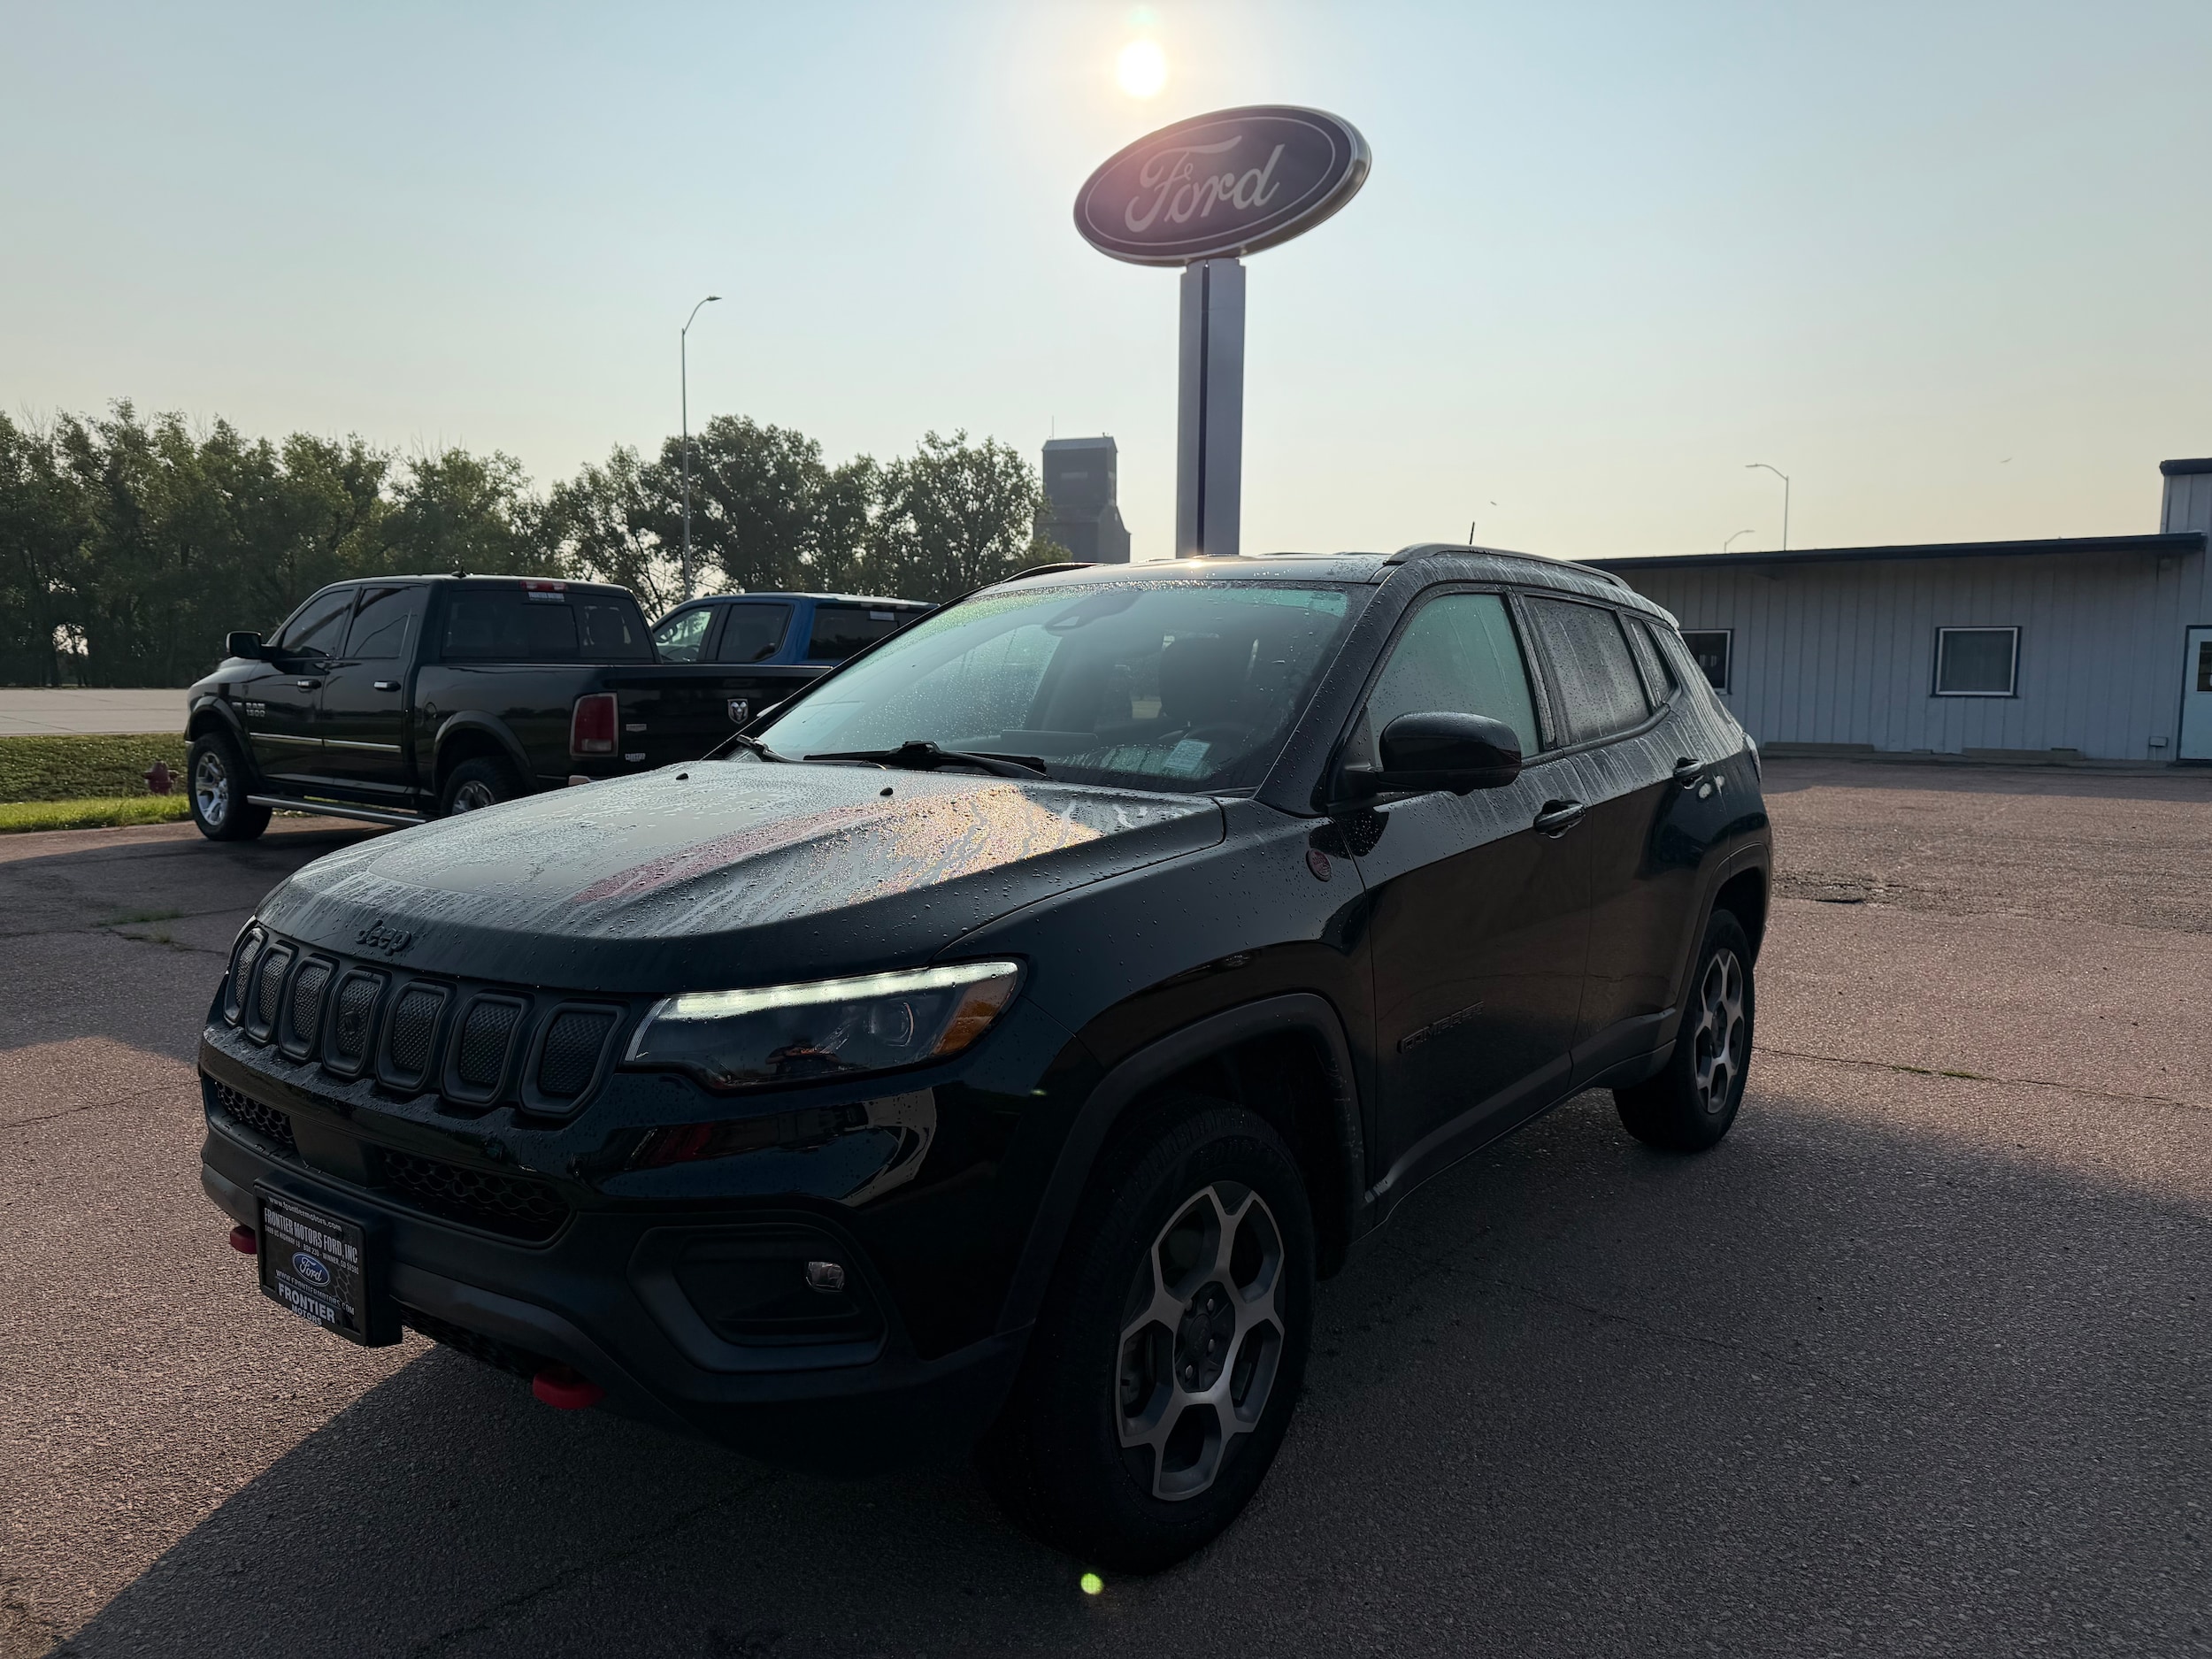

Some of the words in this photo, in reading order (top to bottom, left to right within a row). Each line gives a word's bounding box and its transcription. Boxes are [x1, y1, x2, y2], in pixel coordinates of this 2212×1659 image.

[1125, 135, 1285, 233] Ford
[355, 920, 411, 956] Jeep
[265, 1208, 294, 1236] FRONTIER
[294, 1221, 323, 1248] MOTORS
[299, 1256, 323, 1282] Ford
[278, 1283, 336, 1325] FRONTIER
[291, 1303, 323, 1326] MOTORS
